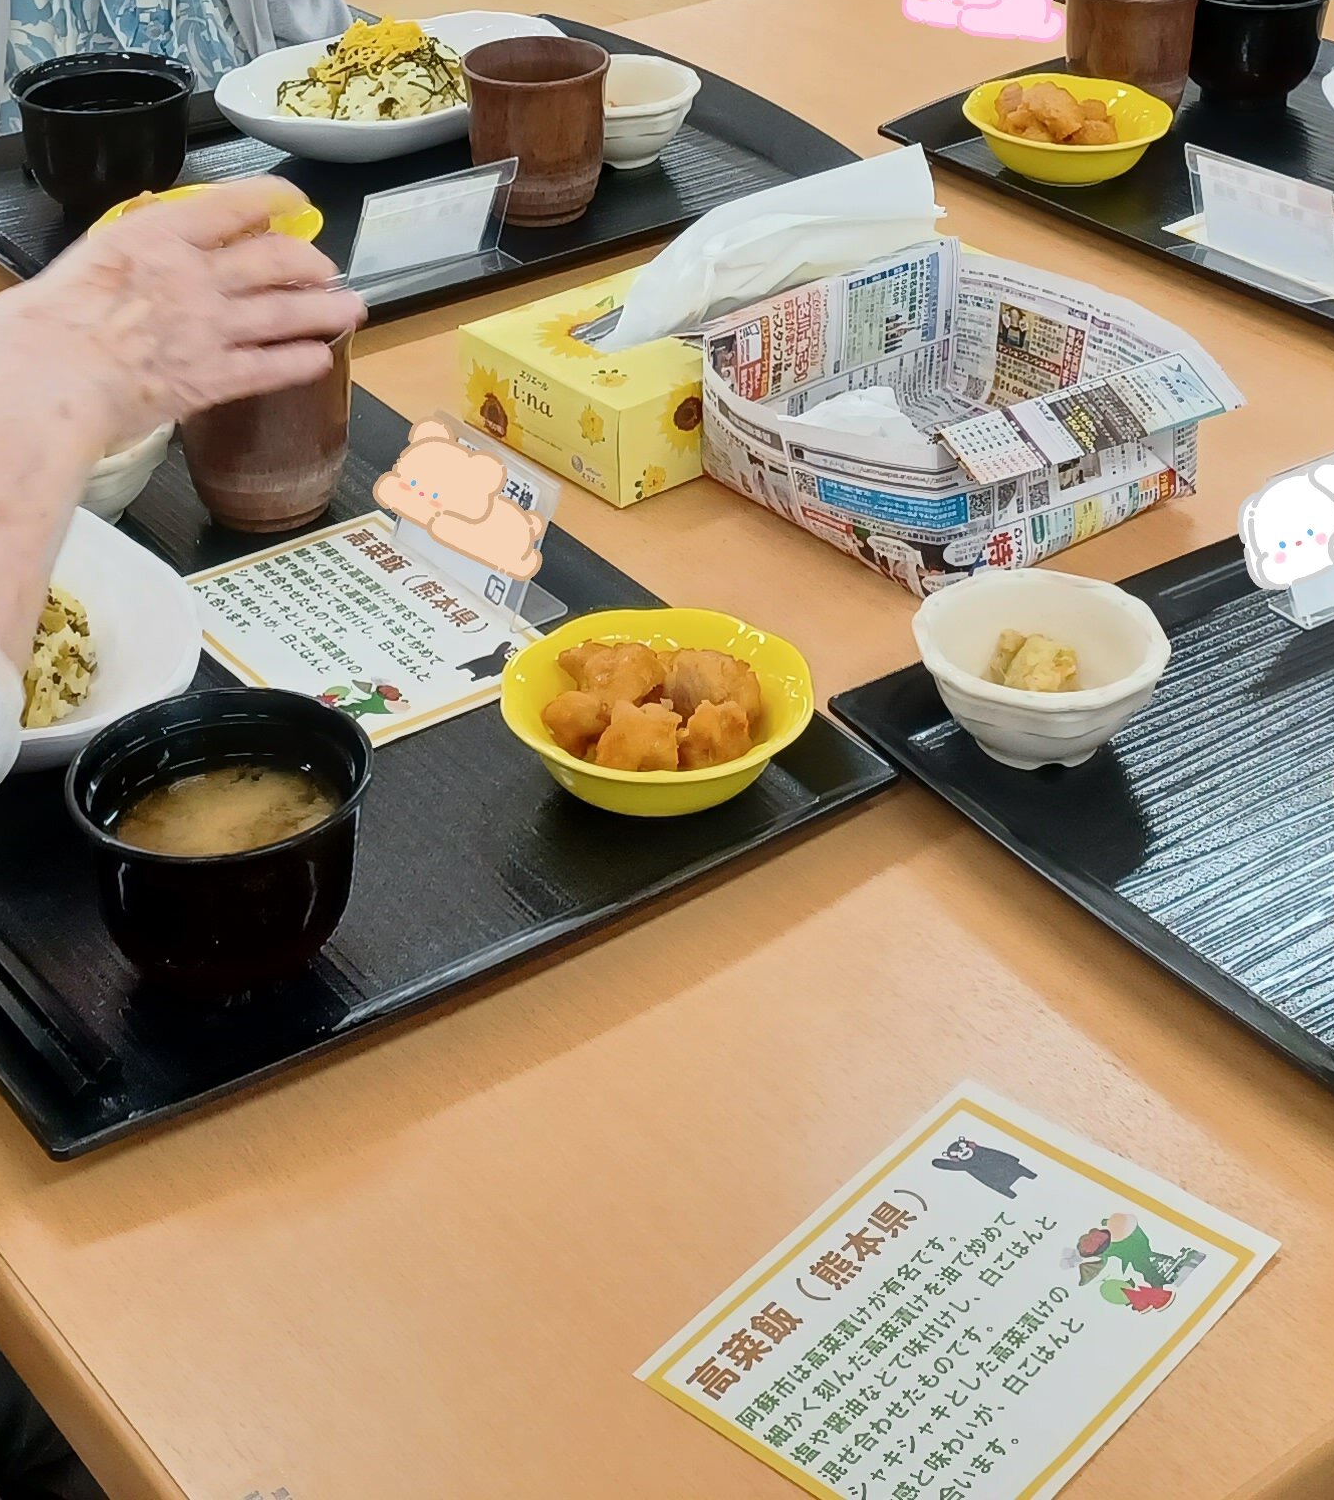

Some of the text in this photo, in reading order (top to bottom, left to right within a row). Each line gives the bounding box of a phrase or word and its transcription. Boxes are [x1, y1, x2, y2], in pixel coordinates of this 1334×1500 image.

[512, 379, 554, 419] i:na
[518, 369, 550, 391] エリエール
[342, 528, 489, 634] 高菜飯（熊本県）
[685, 1188, 928, 1401] 高菜飯（熊本県）
[734, 1236, 957, 1431] 阿蘇市は高菜漬けが有名です。
[763, 1211, 1016, 1448] 細かく刻んだ高菜漬けを油で炒めて
[817, 1326, 994, 1485] 混ぜ合わせたものです。
[847, 1286, 1070, 1500] シャキシャキとした高菜漬けの
